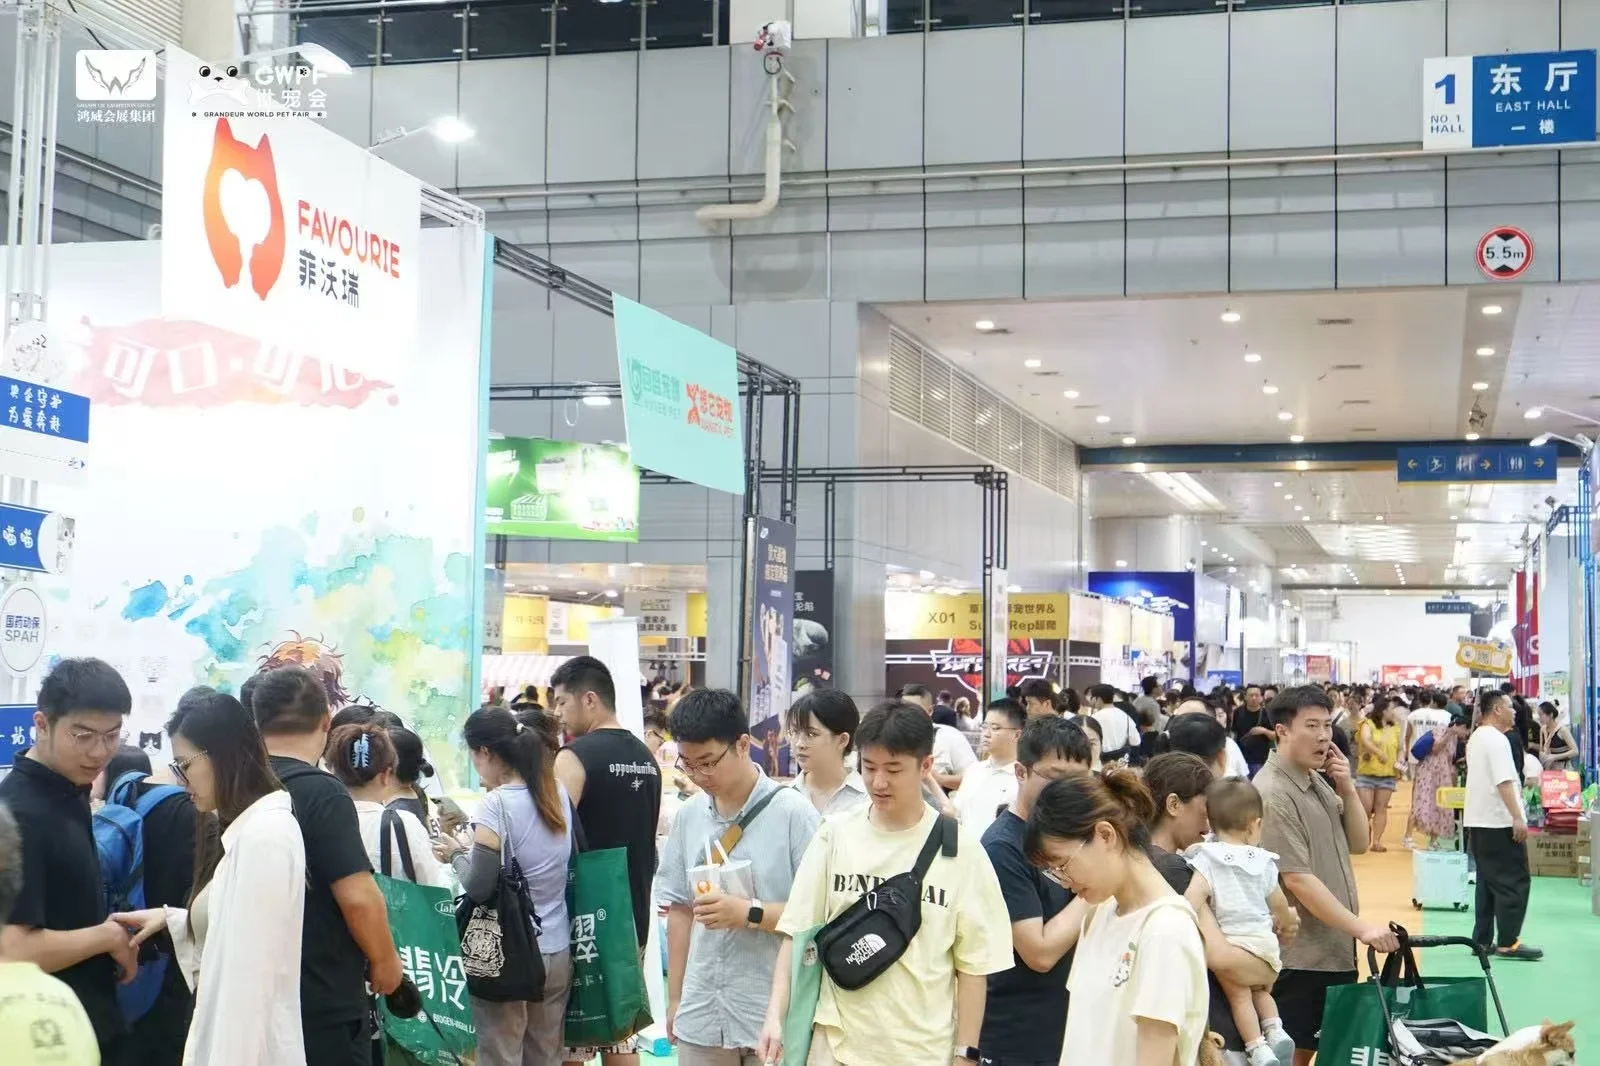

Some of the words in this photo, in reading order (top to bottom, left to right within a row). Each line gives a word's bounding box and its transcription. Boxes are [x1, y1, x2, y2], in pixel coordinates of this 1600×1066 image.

[1490, 62, 1578, 95] 东厅
[1435, 74, 1456, 105] 1
[1495, 101, 1531, 112] EAST
[1537, 100, 1571, 110] HALL
[1430, 125, 1465, 134] HALL
[1511, 119, 1556, 135] 一楼
[298, 199, 400, 279] FAVOURIE
[1486, 246, 1525, 260] 5.5m
[299, 248, 359, 309] 菲沃瑞
[5, 615, 40, 629] 国药动保
[929, 612, 956, 624] X01
[5, 630, 39, 643] SPAH
[851, 937, 870, 951] THE
[846, 943, 872, 964] NORTH
[856, 950, 875, 965] FACE
